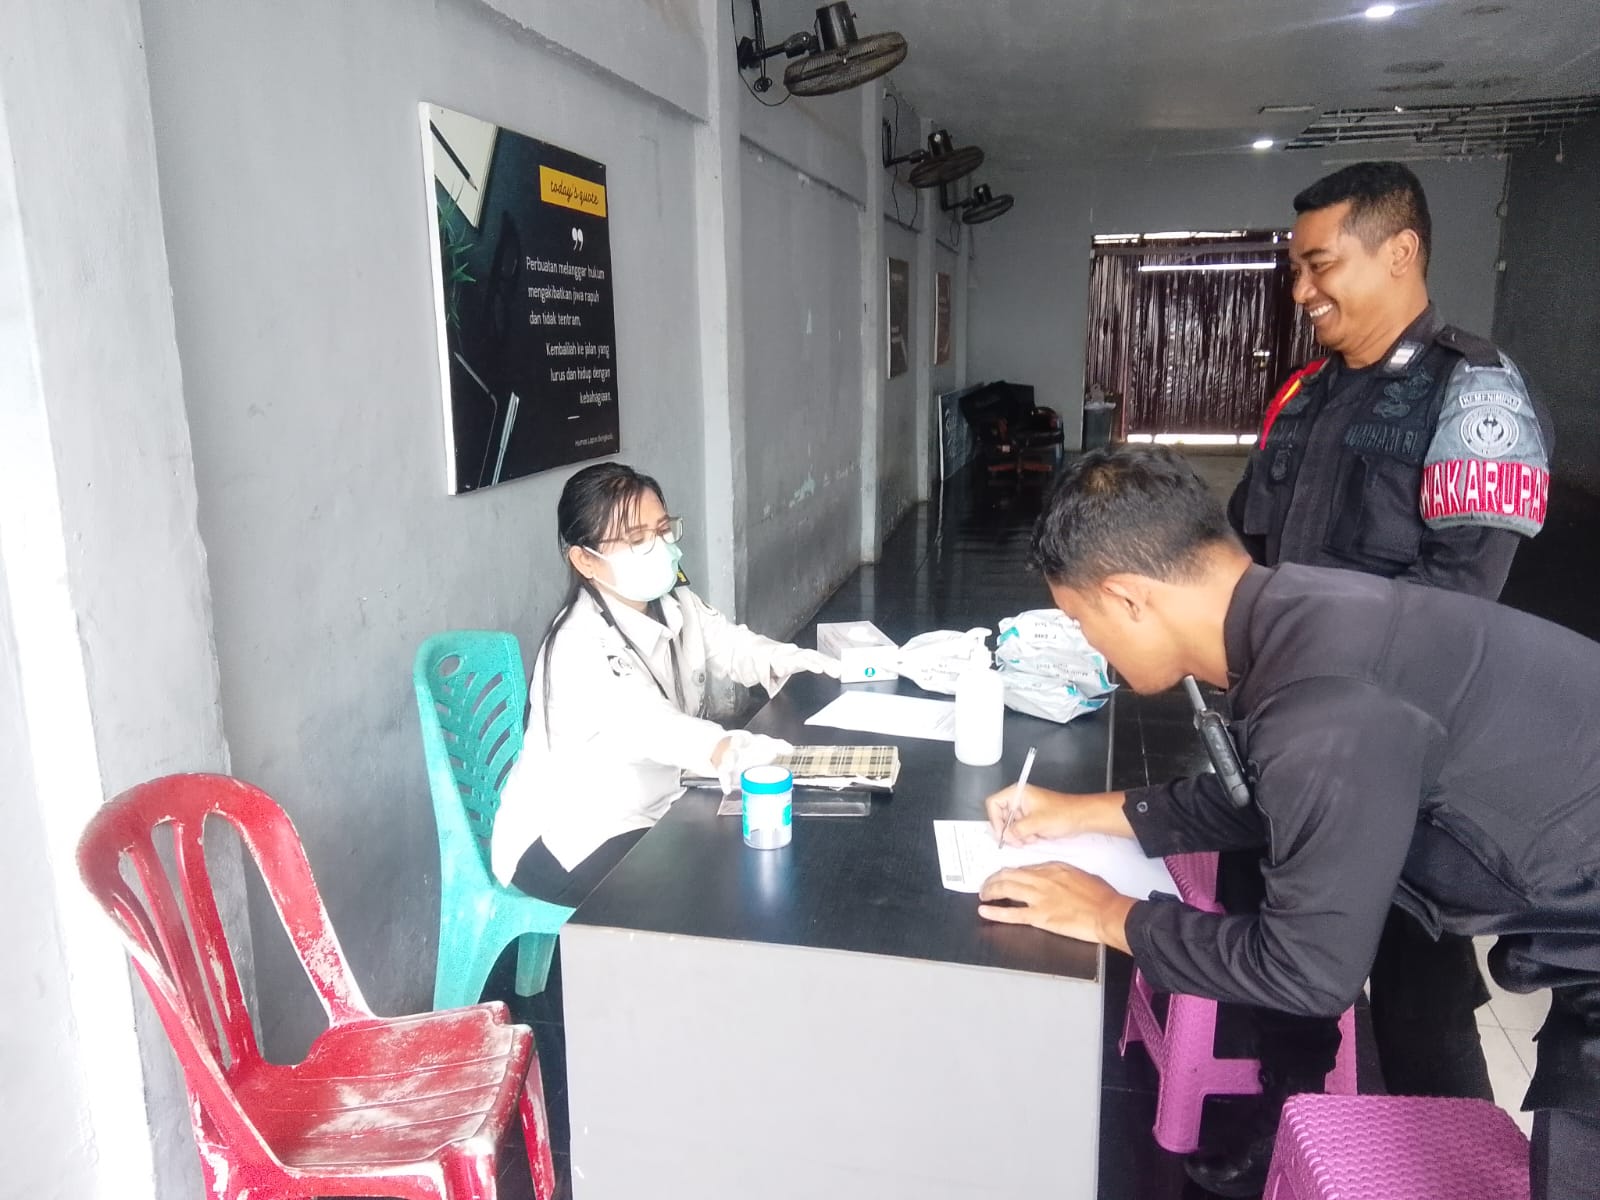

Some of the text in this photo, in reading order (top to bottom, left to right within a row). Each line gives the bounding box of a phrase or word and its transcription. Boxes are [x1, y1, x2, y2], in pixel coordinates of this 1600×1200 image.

[550, 181, 599, 207] today's quote
[526, 256, 605, 281] Perbuatan melanggar hukum
[528, 285, 572, 303] mengakibatkan
[584, 290, 600, 306] rapuh
[529, 311, 541, 325] dan
[542, 312, 557, 325] tidak
[576, 342, 584, 356] ke
[597, 344, 610, 360] yang
[566, 367, 577, 381] dan
[592, 367, 610, 383] dengan
